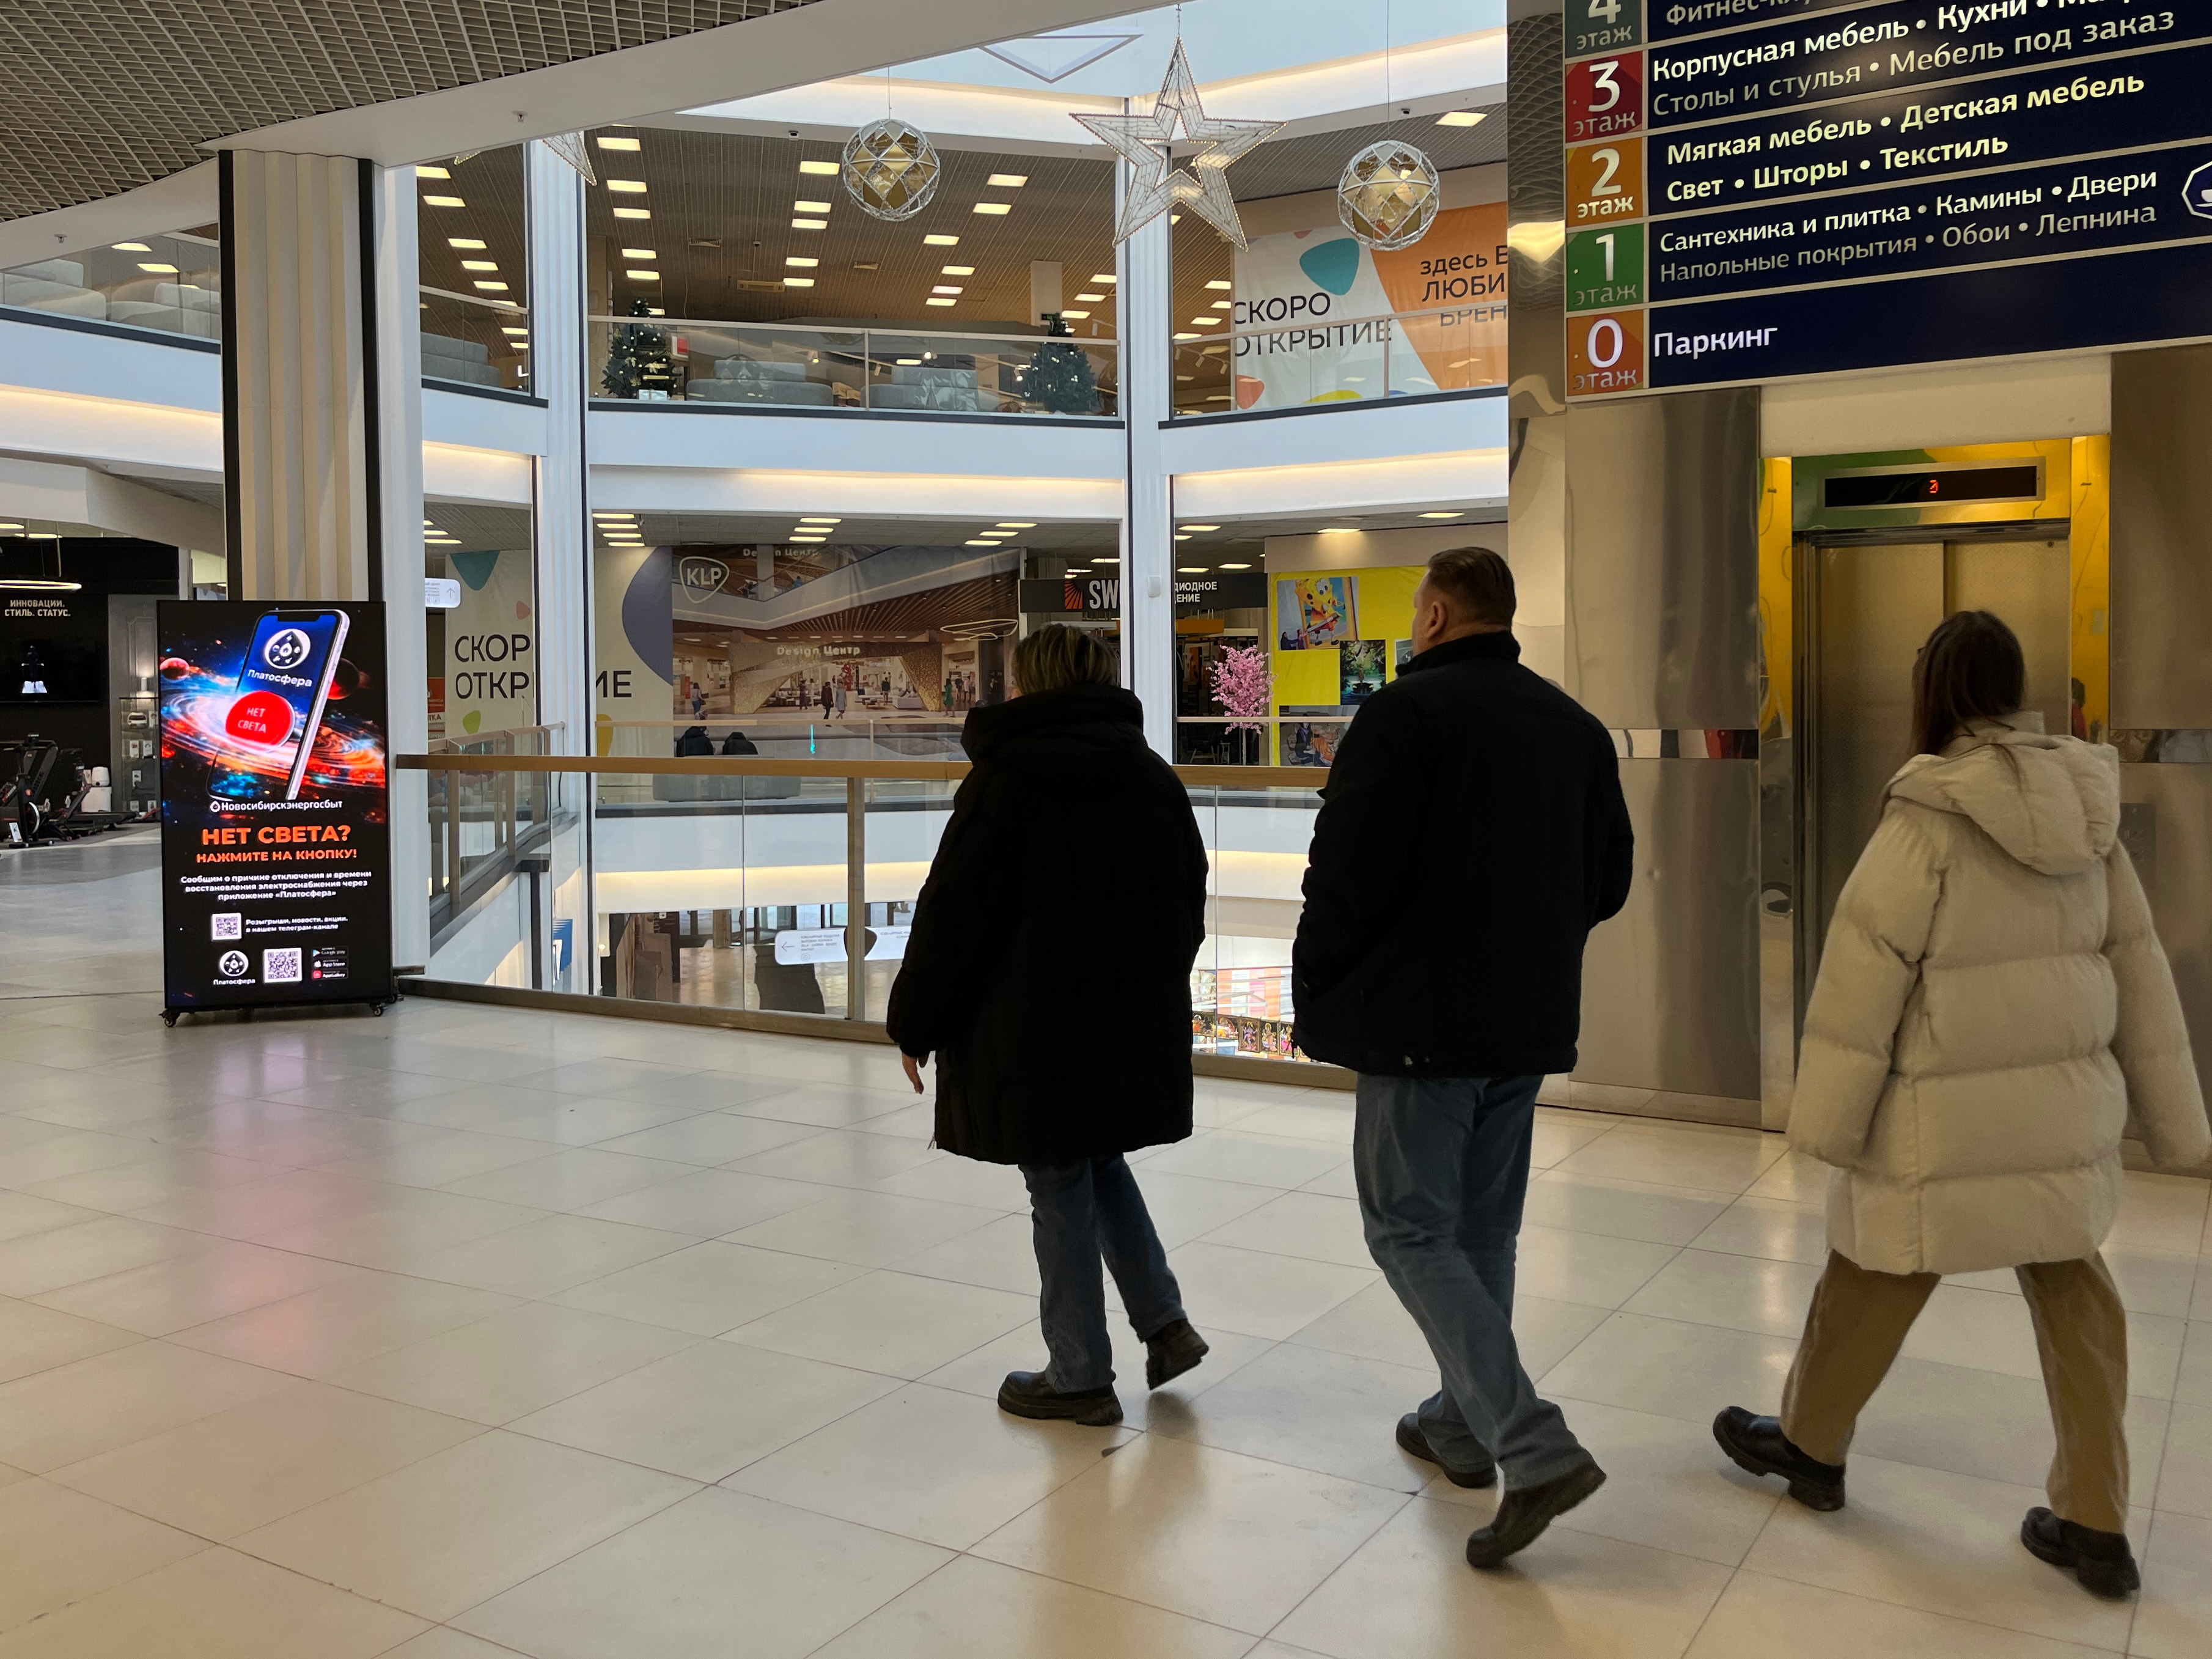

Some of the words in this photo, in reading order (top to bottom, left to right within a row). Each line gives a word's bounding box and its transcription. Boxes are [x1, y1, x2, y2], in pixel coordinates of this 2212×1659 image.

[1666, 0, 1811, 25] Фитнес-
[1576, 25, 1633, 50] этаж
[1654, 40, 1795, 82] Корпусная
[1805, 20, 1909, 55] мебель
[1938, 0, 2027, 33] Кухни
[1654, 87, 1742, 116] Столы
[1744, 84, 1759, 101] и
[1769, 65, 1861, 97] стулья
[1890, 42, 2004, 76] Мебель
[2015, 28, 2071, 54] под
[2083, 11, 2175, 43] заказ
[1587, 60, 1620, 112] 3
[1573, 111, 1636, 136] этаж
[1667, 136, 1762, 165] Мягкая
[1769, 116, 1872, 149] мебель
[1900, 92, 2018, 133] Детская
[2027, 75, 2145, 109] мебель
[1590, 147, 1622, 197] 2
[1667, 178, 1724, 202] Свет
[1754, 158, 1848, 194] Шторы
[1879, 135, 2008, 169] Текстиль
[1577, 195, 1634, 218] этаж
[1660, 218, 1795, 252] Сантехника
[1803, 218, 1817, 233] и
[1824, 204, 1911, 231] плитка
[1936, 187, 2042, 216] Камины
[2067, 172, 2158, 202] Двери
[1660, 251, 1790, 282] Напольные
[1798, 237, 1917, 265] покрытия
[1943, 224, 2010, 247] Обои
[2035, 205, 2158, 237] Лепнина
[1420, 254, 1488, 277] здесь
[1595, 233, 1615, 282] 1
[1422, 272, 1505, 302] ЛЮБИ
[1573, 282, 1637, 306] этаж
[1234, 292, 1331, 325] СКОРО
[1587, 318, 1623, 368] 0
[1654, 327, 1778, 360] Паркинг
[1573, 368, 1637, 391] этаж
[687, 567, 722, 586] KLP
[10, 600, 65, 608] ИННОВАЦИИ.
[1175, 594, 1200, 604] ЕНИЕ
[455, 634, 533, 662] СКОР
[777, 647, 820, 657] Design
[824, 646, 860, 657] Центр
[248, 669, 312, 687] Платосфера
[247, 707, 266, 718] НЕТ
[238, 720, 266, 733] СВЕТА
[222, 800, 343, 812] Новосибирскэнергосбыт
[202, 828, 251, 845] НЕТ
[258, 825, 351, 844] СВЕТА?
[196, 852, 269, 863] НАЖМИТЕ
[273, 851, 293, 861] НА
[296, 849, 357, 860] КНОПКУ!
[185, 884, 257, 892] восстановления
[259, 881, 341, 890] электроснабжения
[218, 892, 273, 901] приложение
[276, 890, 336, 899] «Платосфера»
